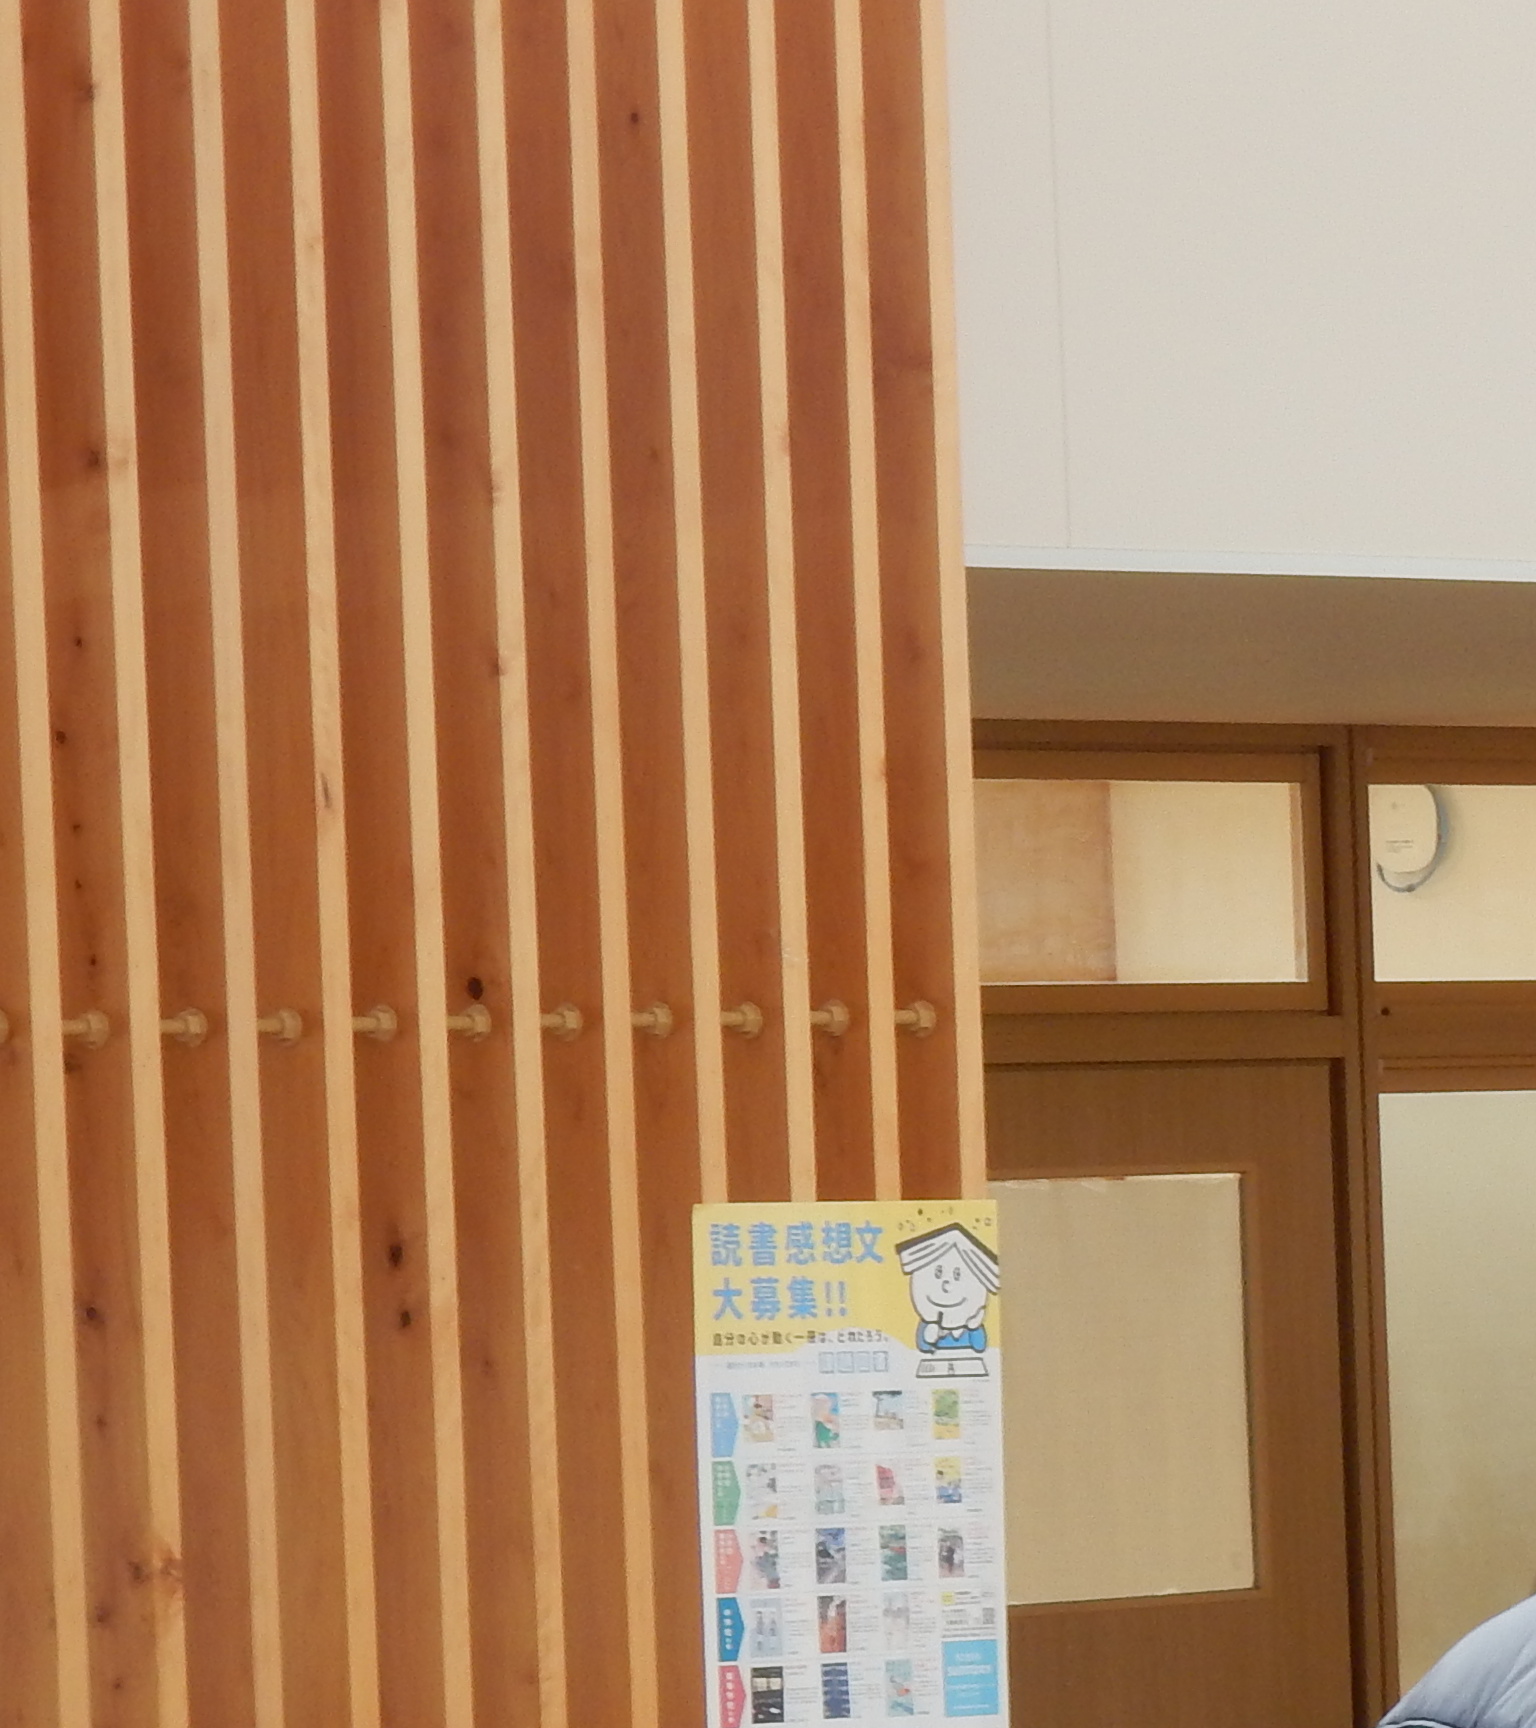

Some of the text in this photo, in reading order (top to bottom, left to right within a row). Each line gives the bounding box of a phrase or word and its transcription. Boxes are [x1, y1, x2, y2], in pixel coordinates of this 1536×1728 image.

[709, 1220, 885, 1267] 読書感想文
